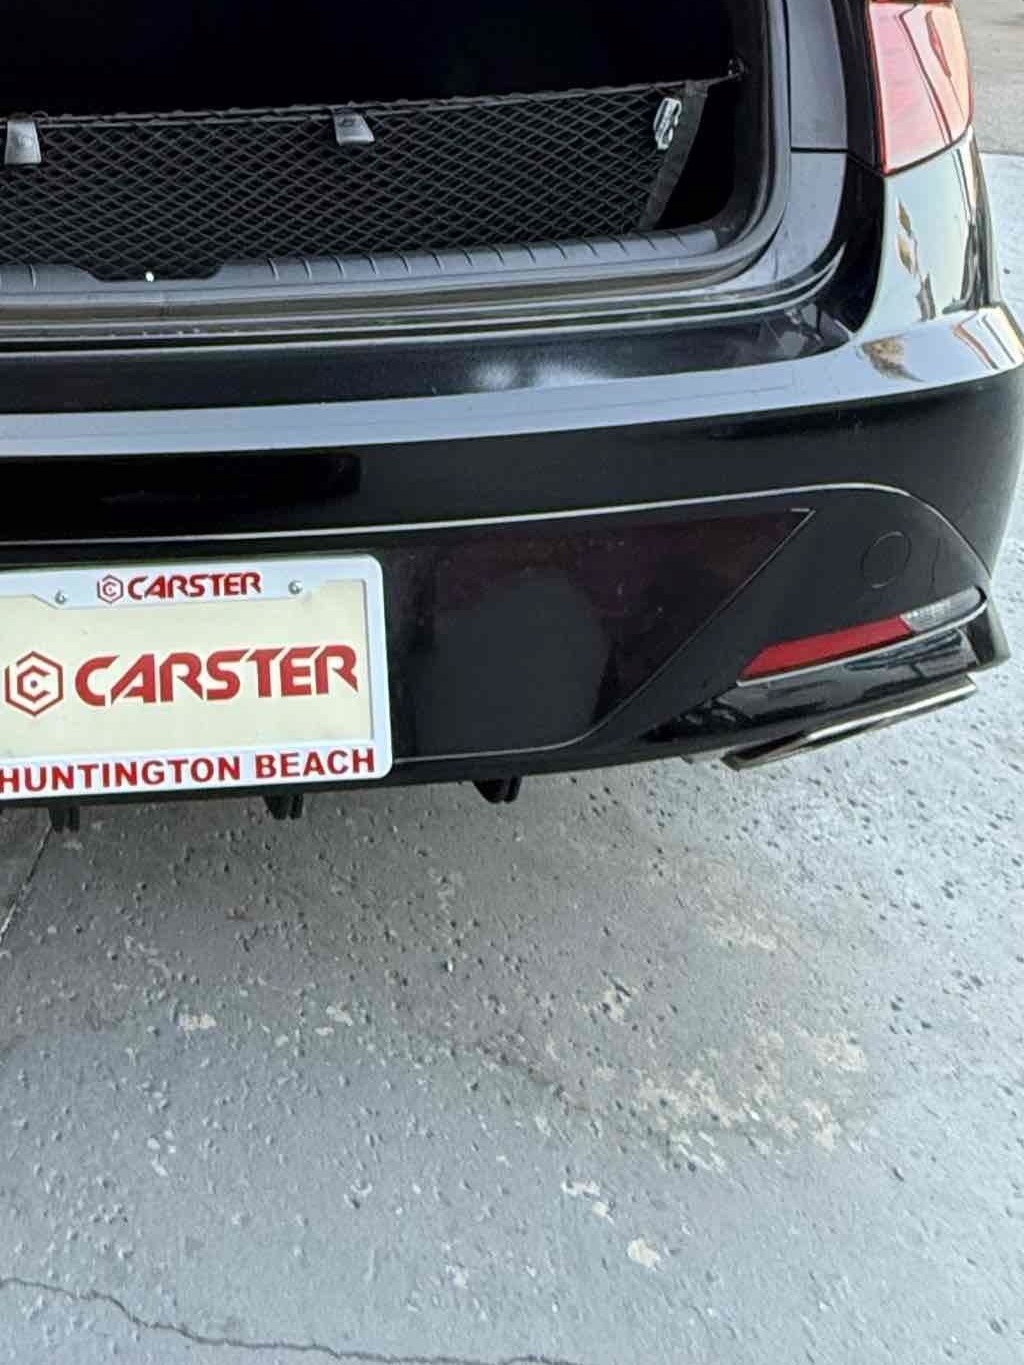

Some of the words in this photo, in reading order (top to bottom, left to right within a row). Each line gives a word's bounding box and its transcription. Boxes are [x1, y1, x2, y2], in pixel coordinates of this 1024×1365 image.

[127, 571, 262, 601] CARSTER
[74, 644, 360, 708] CARSTER
[255, 749, 375, 779] BEACH
